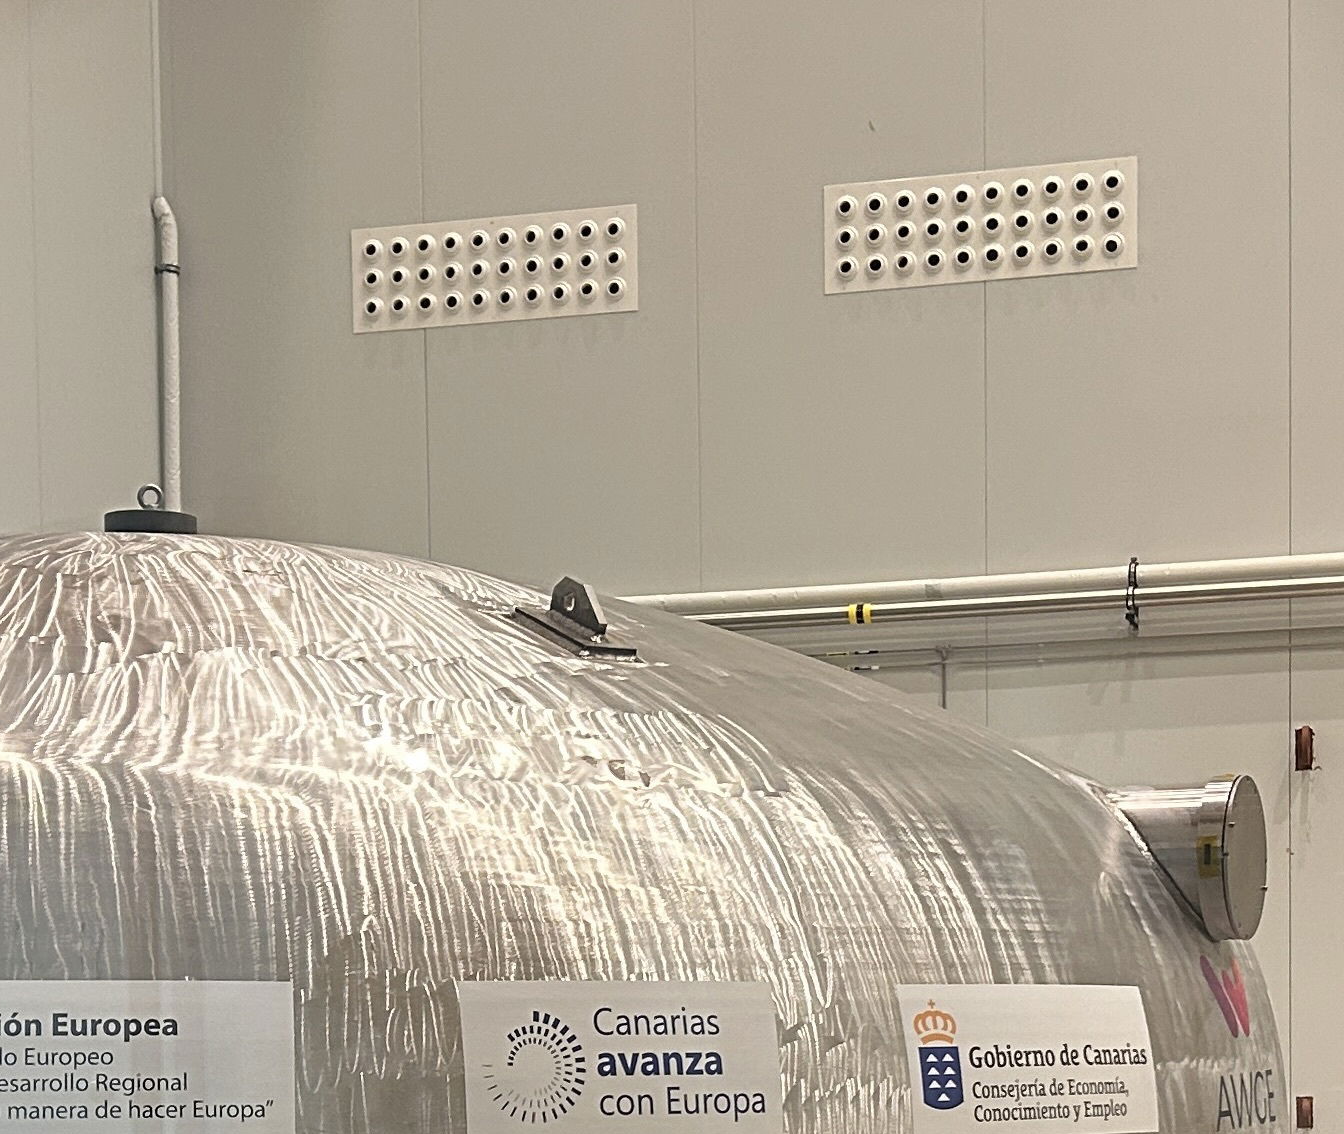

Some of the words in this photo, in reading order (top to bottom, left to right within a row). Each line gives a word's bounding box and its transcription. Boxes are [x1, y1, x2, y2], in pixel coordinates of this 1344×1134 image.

[51, 1013, 179, 1042] Europea
[593, 1006, 721, 1036] Canarias
[24, 1047, 115, 1072] Europeo
[597, 1050, 724, 1077] avanza
[969, 1044, 1056, 1069] Gobierno
[1059, 1043, 1080, 1066] de
[1083, 1042, 1148, 1065] Canarias
[95, 1072, 189, 1097] Regional
[972, 1077, 1047, 1102] Consejería
[1049, 1077, 1065, 1096] de
[1066, 1076, 1129, 1098] Economía,
[8, 1104, 91, 1121] manera
[95, 1099, 124, 1120] de
[128, 1099, 188, 1120] hacer
[599, 1092, 655, 1116] con
[666, 1086, 767, 1123] Europa
[974, 1101, 1070, 1123] Conocimiento
[1072, 1104, 1082, 1123] y
[1083, 1098, 1128, 1122] Empleo
